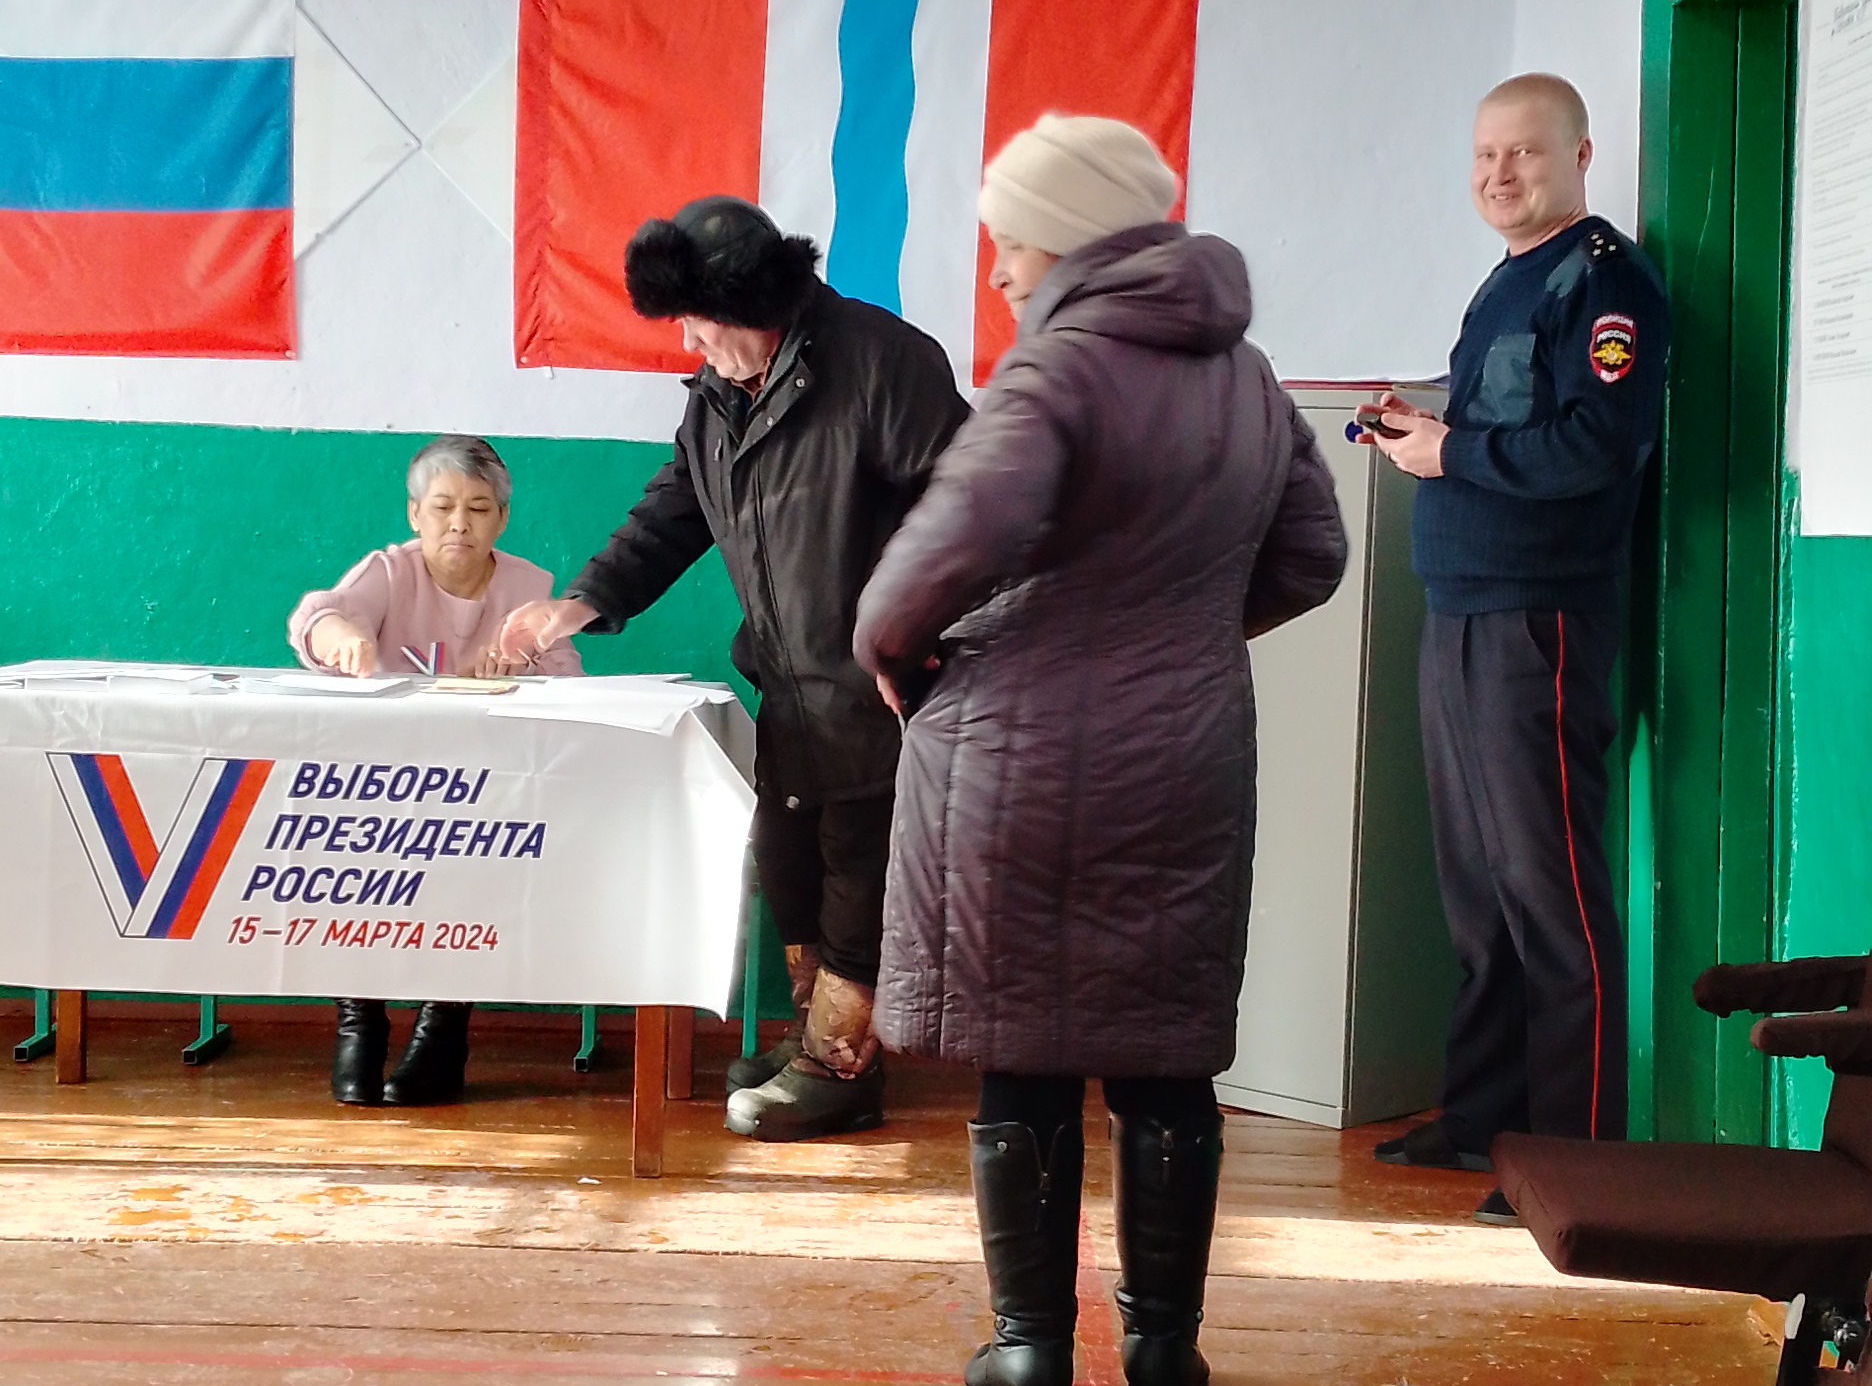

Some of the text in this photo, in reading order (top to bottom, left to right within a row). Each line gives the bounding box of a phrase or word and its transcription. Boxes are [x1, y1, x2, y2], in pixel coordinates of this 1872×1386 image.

[1596, 330, 1632, 344] РОССИЯ
[287, 762, 491, 804] ВЫБОРЫ
[265, 814, 546, 861] ПРЕЗИДЕНТА
[241, 866, 425, 906] РОССИИ
[321, 921, 424, 949] МАРТА
[432, 923, 499, 951] 2024
